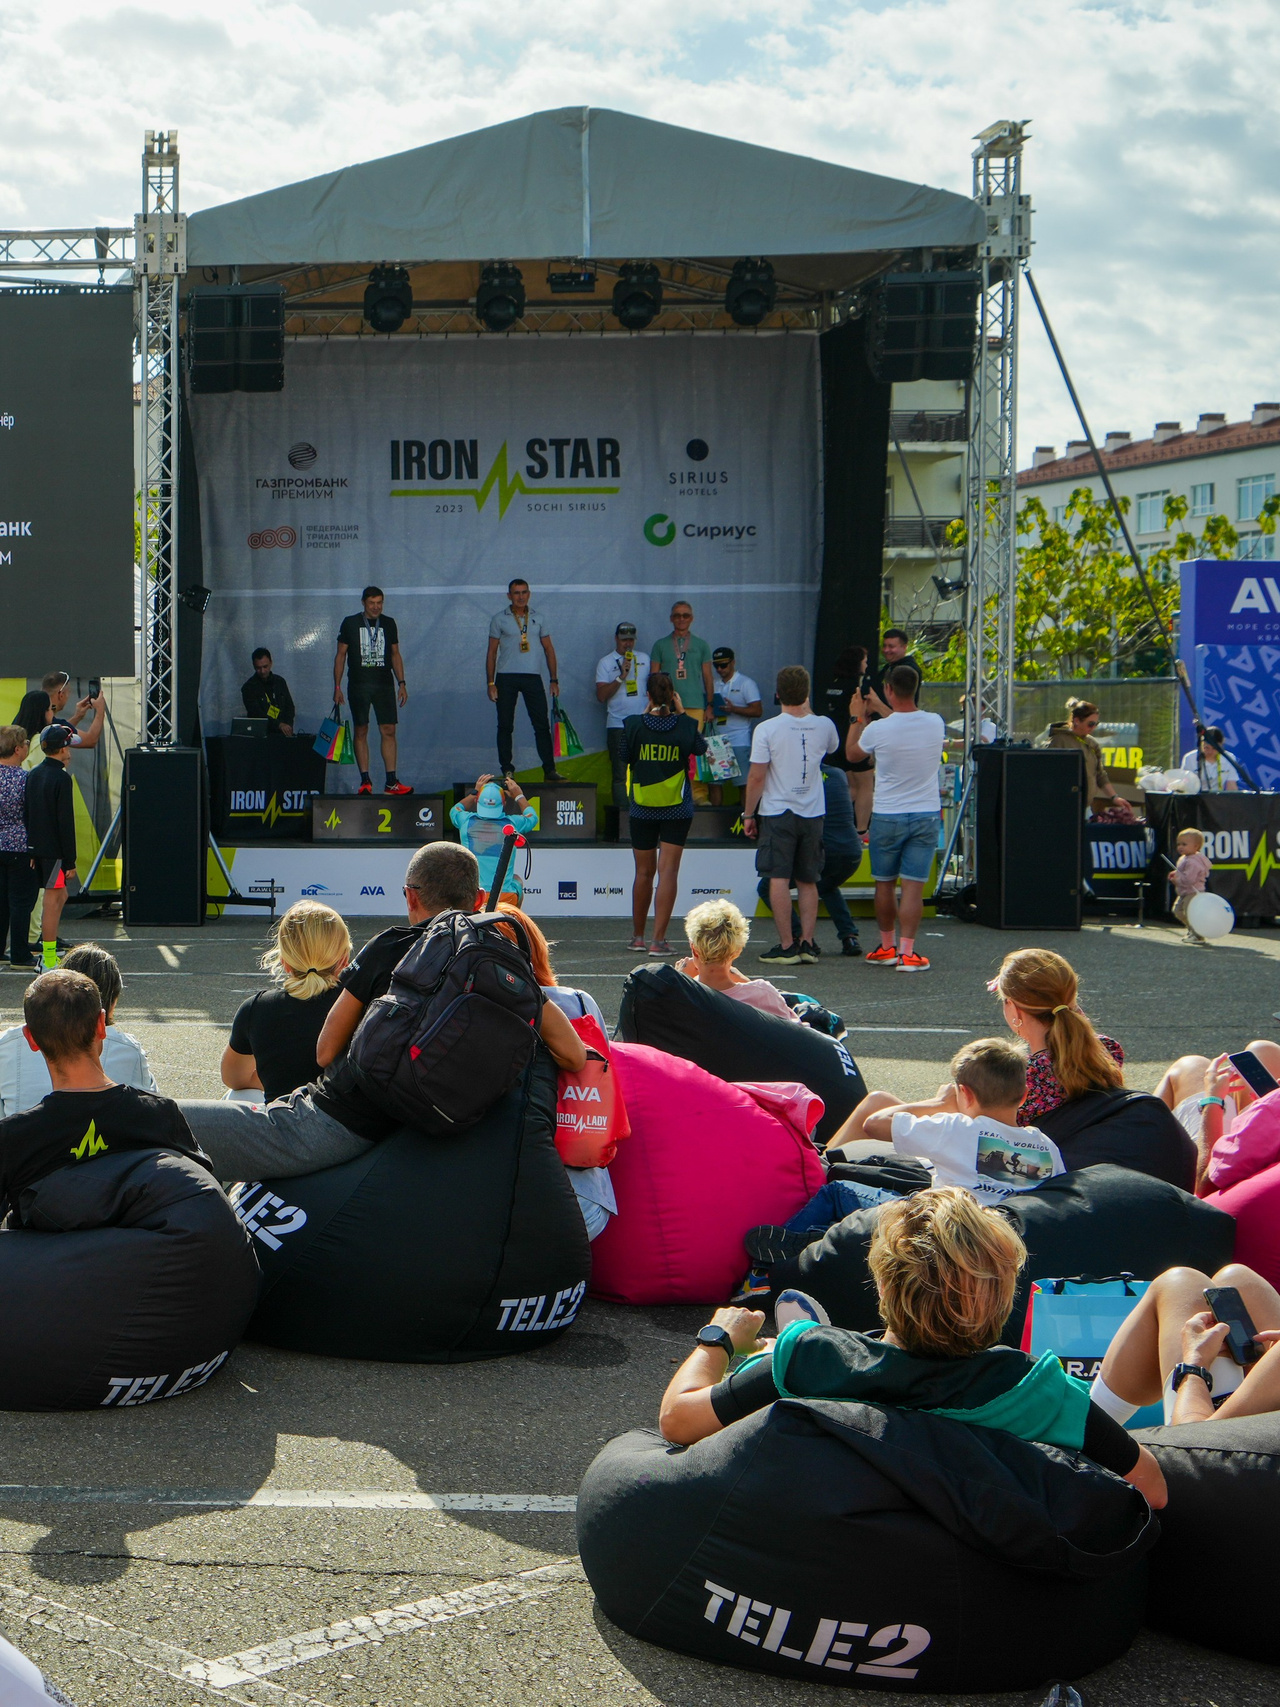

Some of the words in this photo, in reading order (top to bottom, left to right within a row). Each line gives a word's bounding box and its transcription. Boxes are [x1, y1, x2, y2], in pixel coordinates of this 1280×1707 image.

[391, 439, 479, 480] IRON
[526, 438, 621, 479] STAR
[255, 478, 349, 489] ГАЗПРОМБАНК
[669, 471, 729, 485] SIRIUS
[272, 489, 334, 500] ПРЕМИУМ
[679, 488, 718, 496] HOTELS
[435, 504, 464, 513] 2023
[527, 503, 563, 512] SOCHI
[568, 502, 607, 511] SIRIUS
[306, 525, 359, 533] ФЕДЕРАЦИЯ
[683, 524, 757, 540] Сириус
[306, 541, 341, 549] РОССИИ
[639, 744, 680, 761] MEDIA
[1101, 747, 1144, 769] TAR
[230, 790, 265, 810] IRON
[283, 790, 320, 810] STA
[557, 800, 576, 811] IRON
[377, 808, 392, 833] 2
[556, 811, 584, 826] STAR
[1203, 830, 1250, 859] RON
[1090, 840, 1147, 869] IRON
[360, 886, 385, 896] AVA
[562, 1085, 602, 1103] AVA
[556, 1112, 577, 1125] IRON
[586, 1115, 608, 1127] LADY
[496, 1279, 586, 1332] TELE2
[100, 1350, 229, 1406] TELE2
[704, 1579, 932, 1680] TELE2
